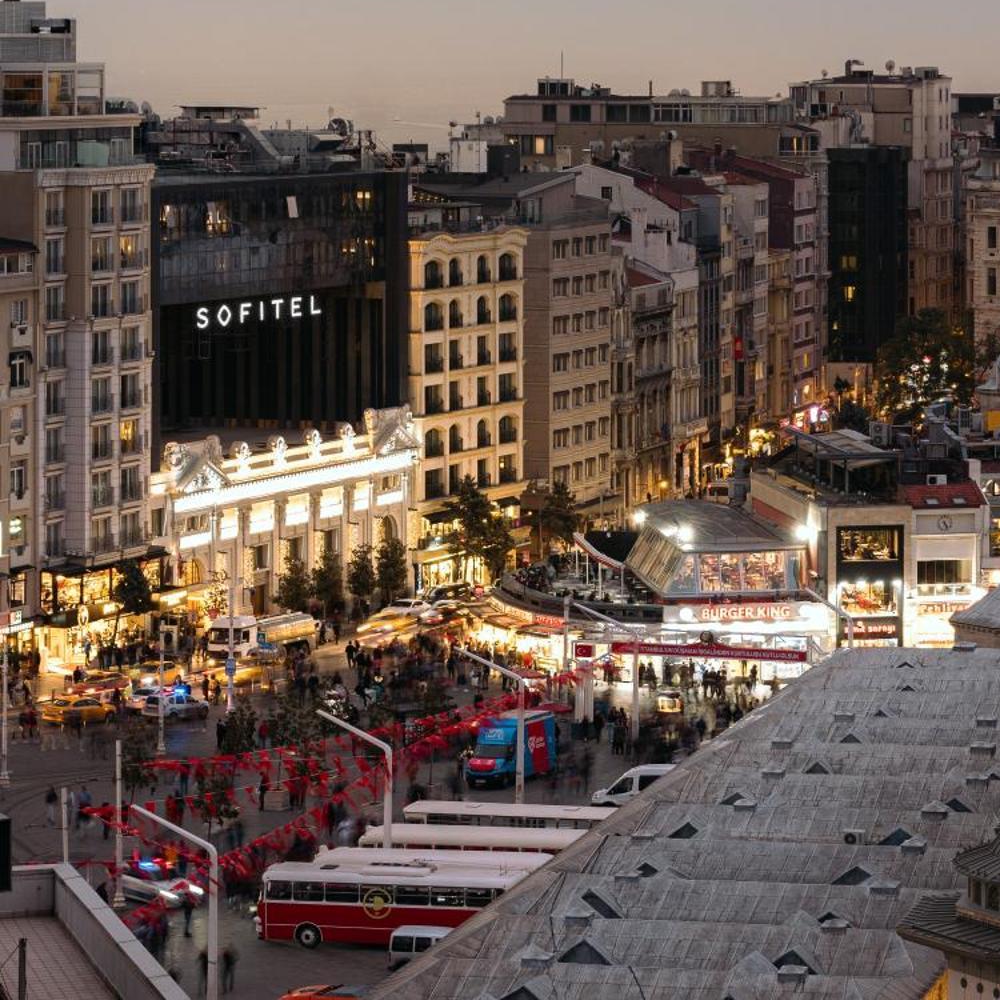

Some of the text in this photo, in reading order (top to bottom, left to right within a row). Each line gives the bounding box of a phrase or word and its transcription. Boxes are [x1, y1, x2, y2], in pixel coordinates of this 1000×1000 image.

[197, 295, 322, 329] SOFITEL
[702, 606, 790, 619] BURGER KING
